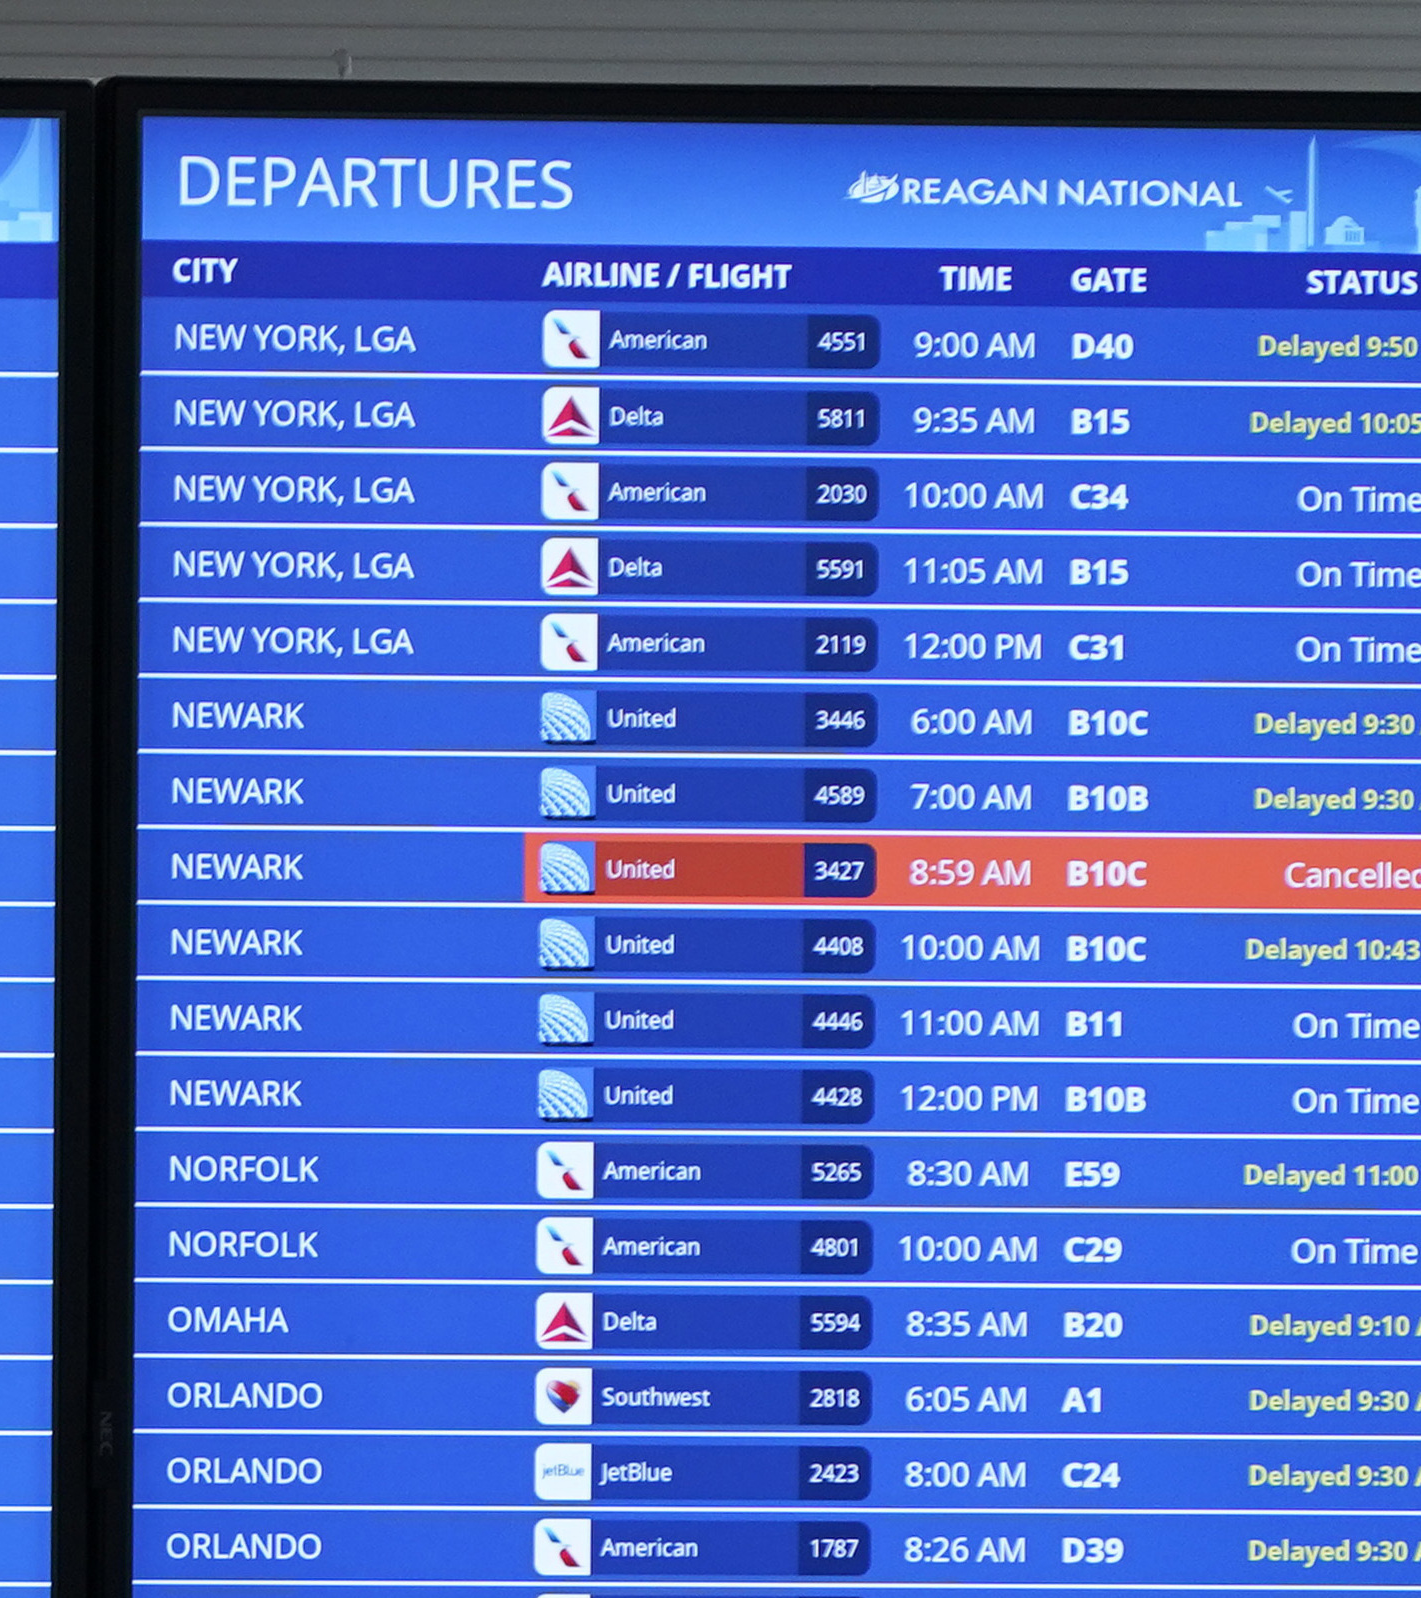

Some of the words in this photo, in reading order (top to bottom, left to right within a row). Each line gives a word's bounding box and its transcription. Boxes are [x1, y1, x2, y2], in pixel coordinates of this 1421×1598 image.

[179, 155, 573, 210] DEPARTURES
[901, 177, 1048, 206] REAGAN
[1057, 179, 1243, 208] NATIONAL
[172, 257, 239, 284] CITY
[541, 261, 660, 289] AIRLINE
[665, 263, 681, 289] /
[687, 263, 793, 290] FLIGHT
[938, 265, 1013, 292] TIME
[1070, 267, 1147, 293] GATE
[1306, 269, 1418, 296] STATUS
[174, 399, 247, 427] NEW
[252, 399, 345, 432] YORK,
[354, 400, 416, 429] LGA
[609, 405, 664, 427] Delta
[817, 408, 864, 429] 5811
[912, 406, 978, 434] 9:35
[984, 407, 1035, 434] AM
[1070, 408, 1131, 436] B15
[1249, 410, 1352, 441] Delayed
[1358, 412, 1421, 435] 10:05
[169, 1079, 302, 1107] NEWARK
[605, 1084, 674, 1106] United
[810, 1087, 863, 1107] 4428
[901, 1084, 983, 1112] 12:00
[991, 1085, 1038, 1112] PM
[1065, 1086, 1147, 1113] B10B
[1292, 1087, 1338, 1114] On
[1344, 1087, 1420, 1115] Time
